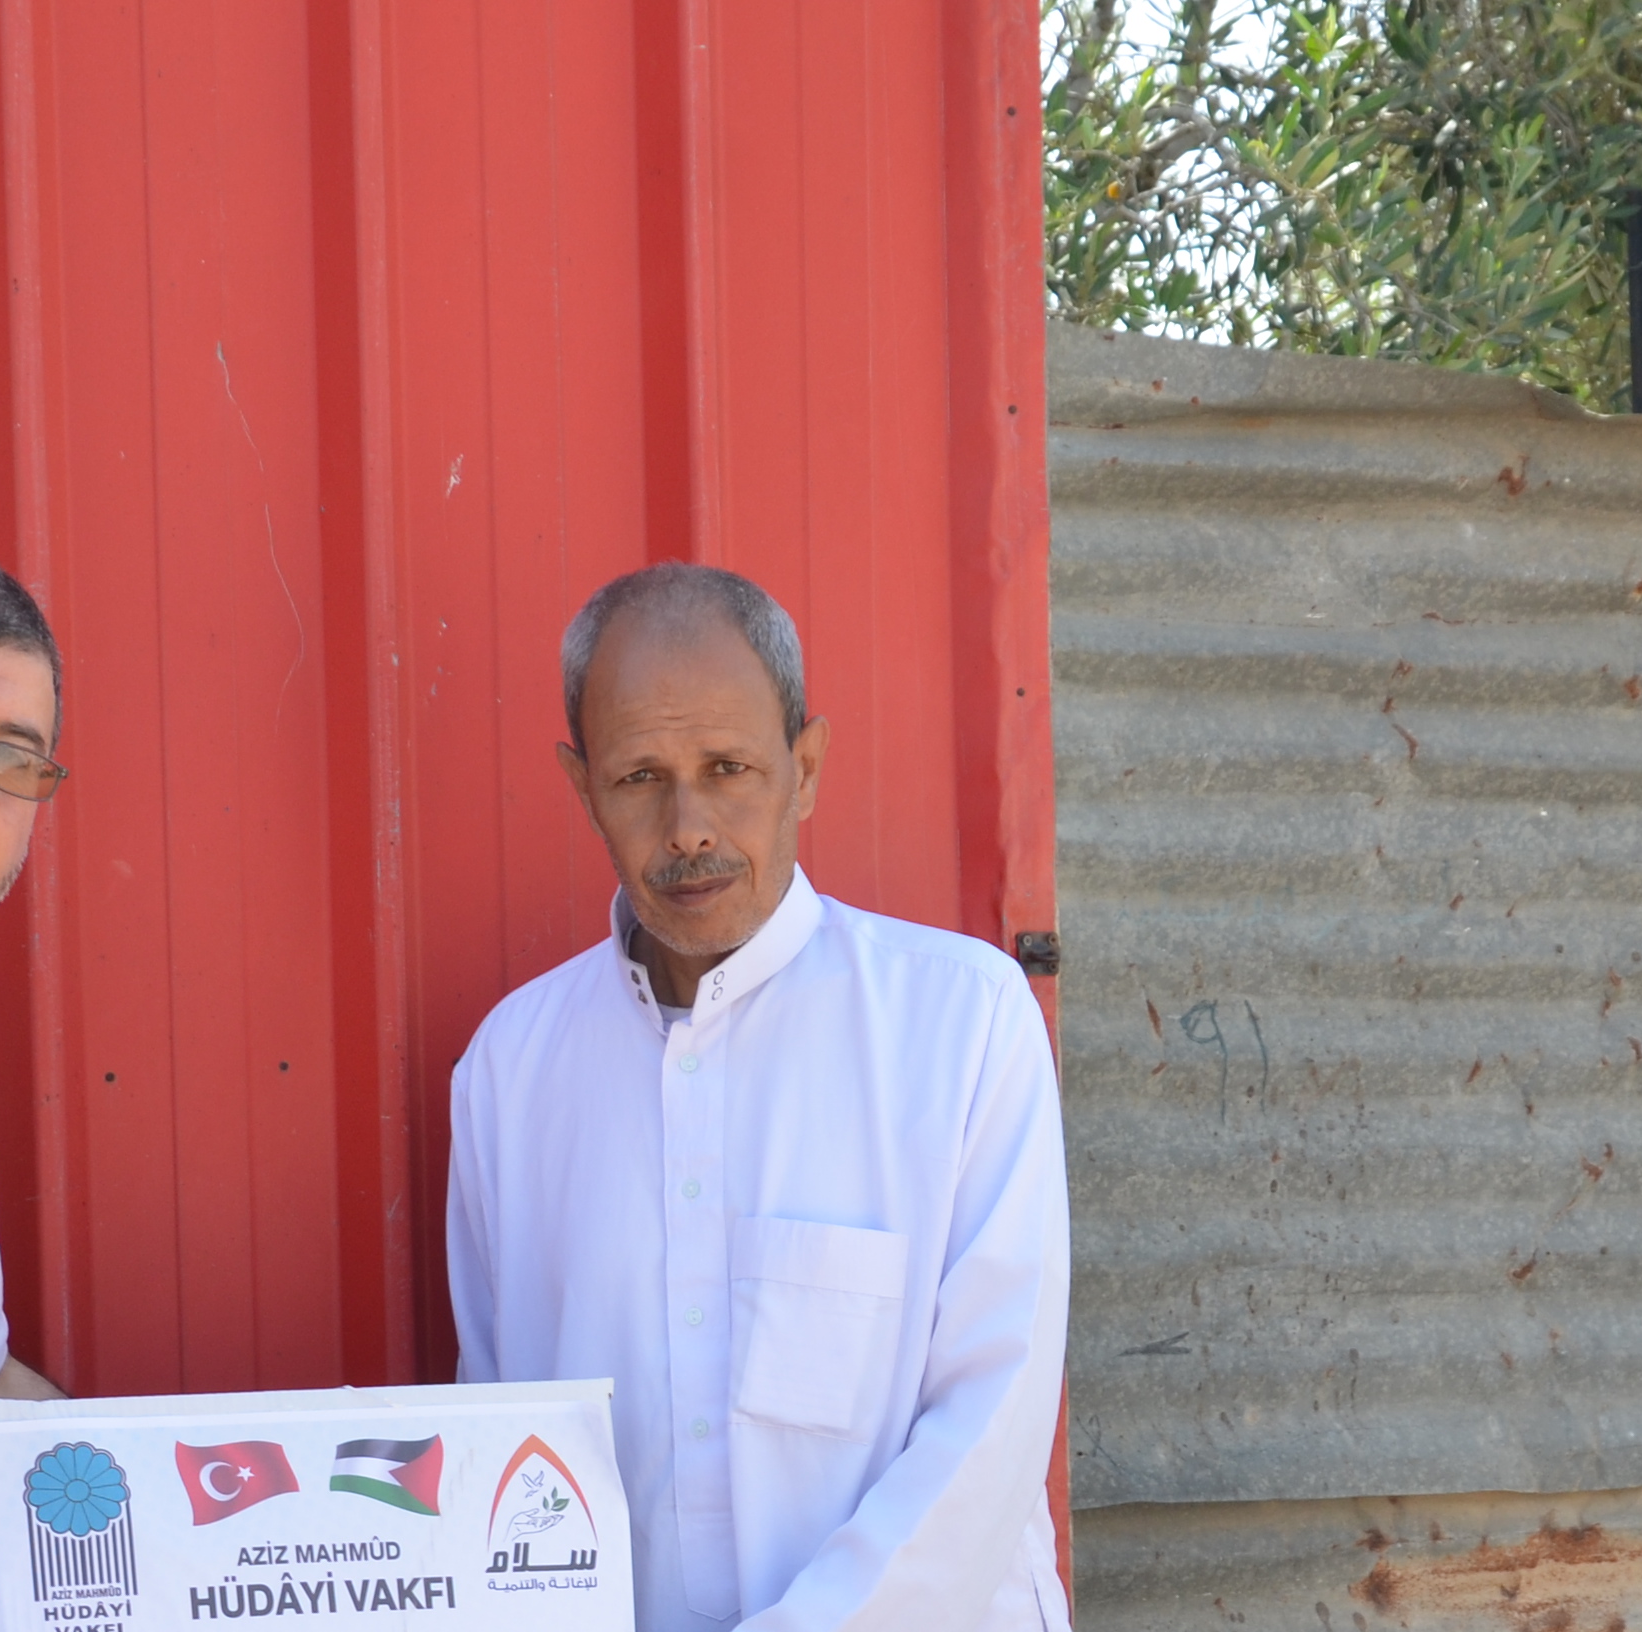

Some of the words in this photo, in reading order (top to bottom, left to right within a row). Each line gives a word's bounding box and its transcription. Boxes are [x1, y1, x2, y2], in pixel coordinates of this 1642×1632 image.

[237, 1540, 289, 1566] AZİZ
[295, 1535, 401, 1563] MAHMÛD
[485, 1541, 597, 1573] سلام
[189, 1571, 337, 1620] HÜDÂYİ
[344, 1576, 456, 1612] VAKFI
